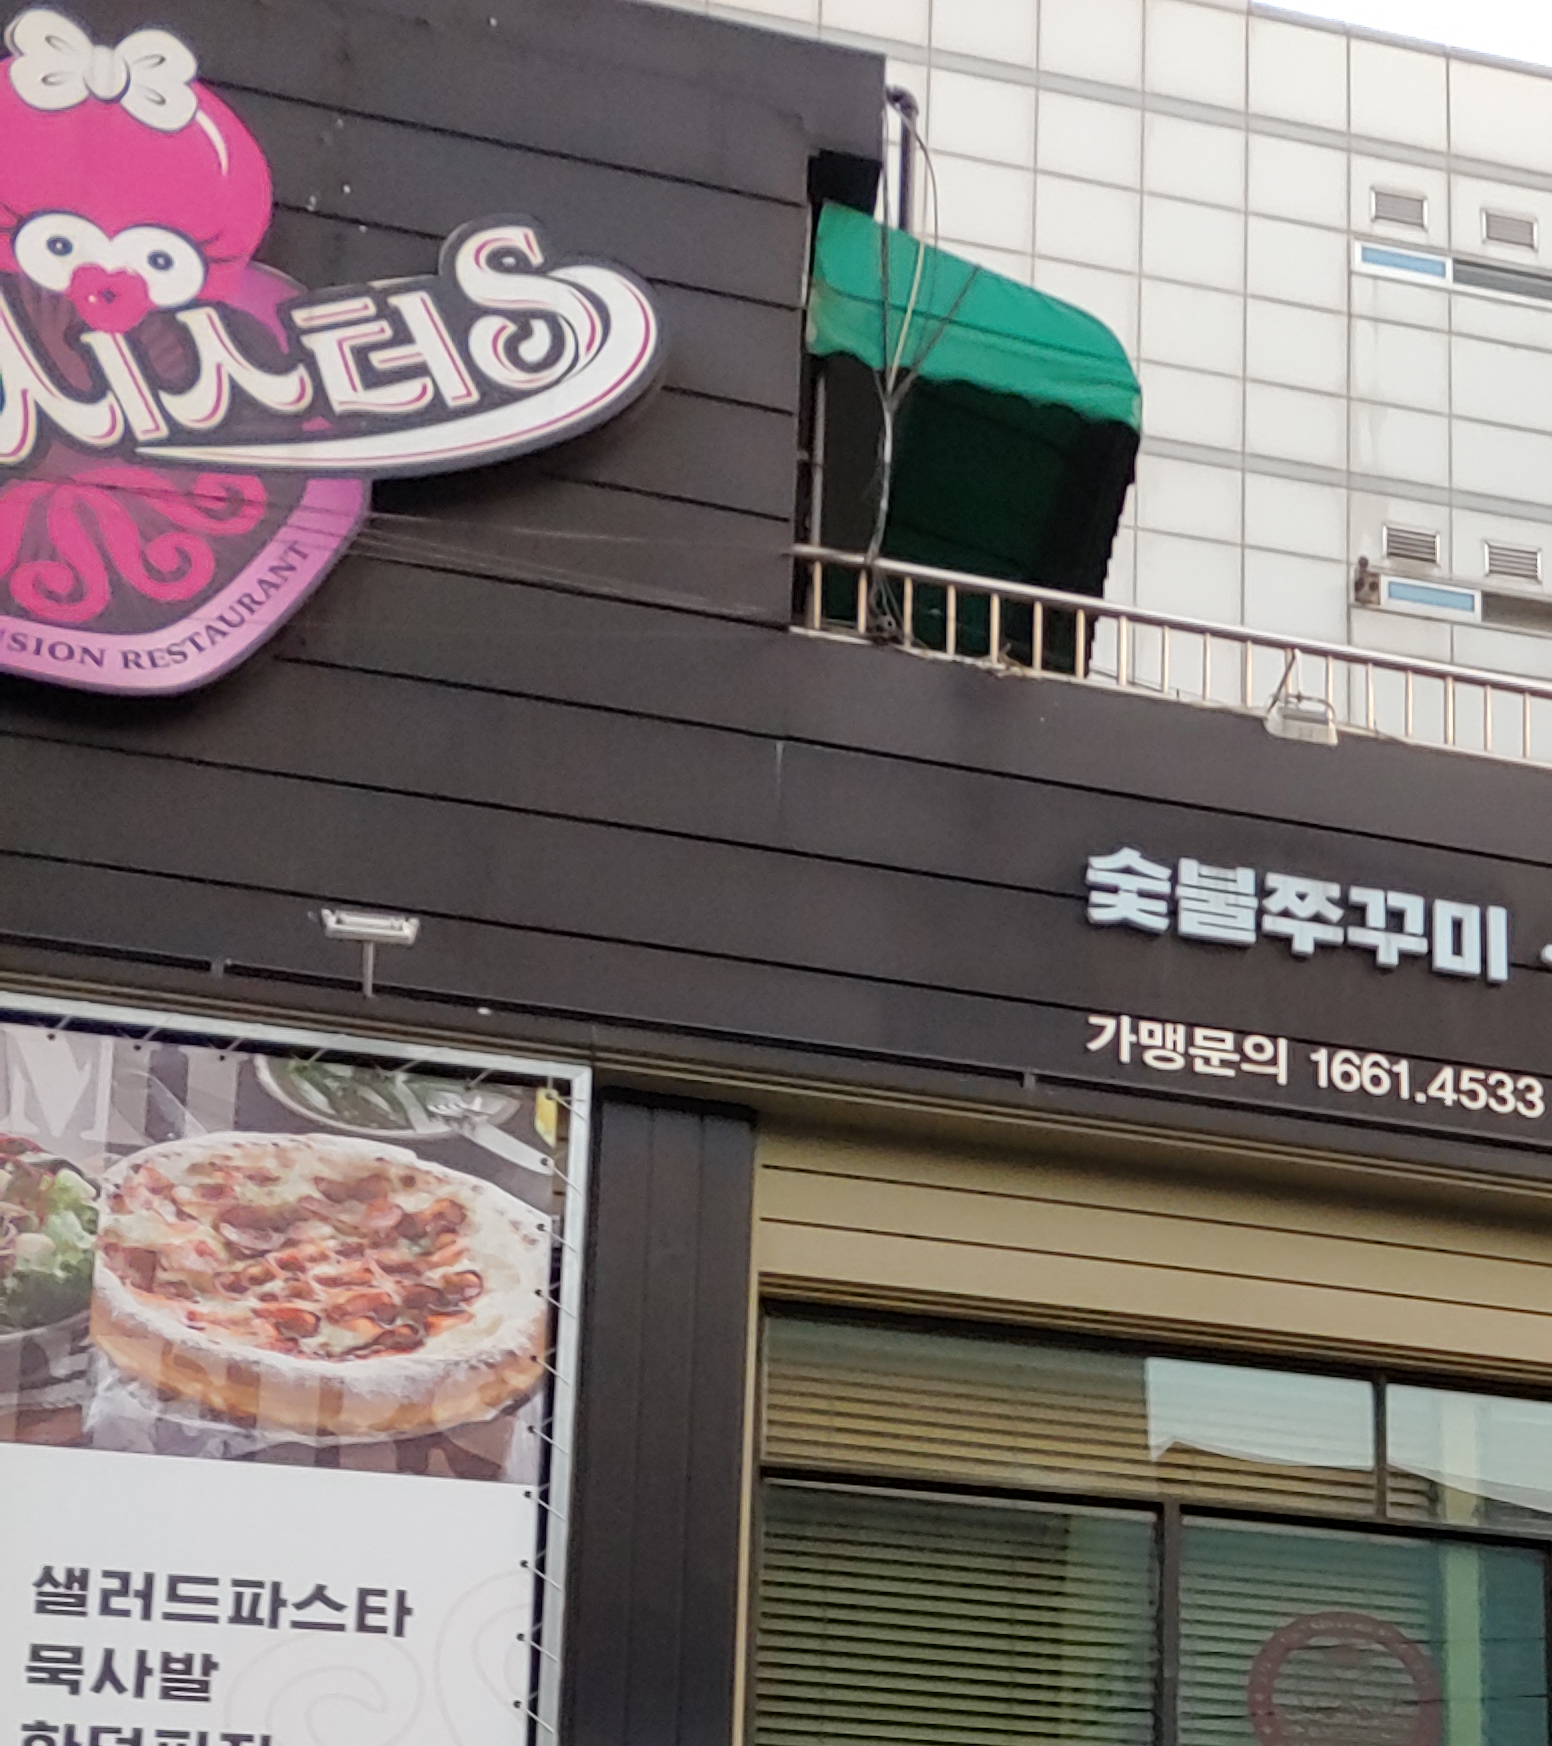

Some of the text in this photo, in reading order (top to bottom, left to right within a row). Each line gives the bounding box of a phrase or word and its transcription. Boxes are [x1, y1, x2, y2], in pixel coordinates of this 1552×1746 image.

[0, 540, 312, 672] SION RESTAURANT
[1086, 846, 1510, 983] 숯불쭈꾸미
[1086, 1014, 1546, 1120] 가맹문의 1661.4533
[25, 1643, 219, 1702] 묵사발
